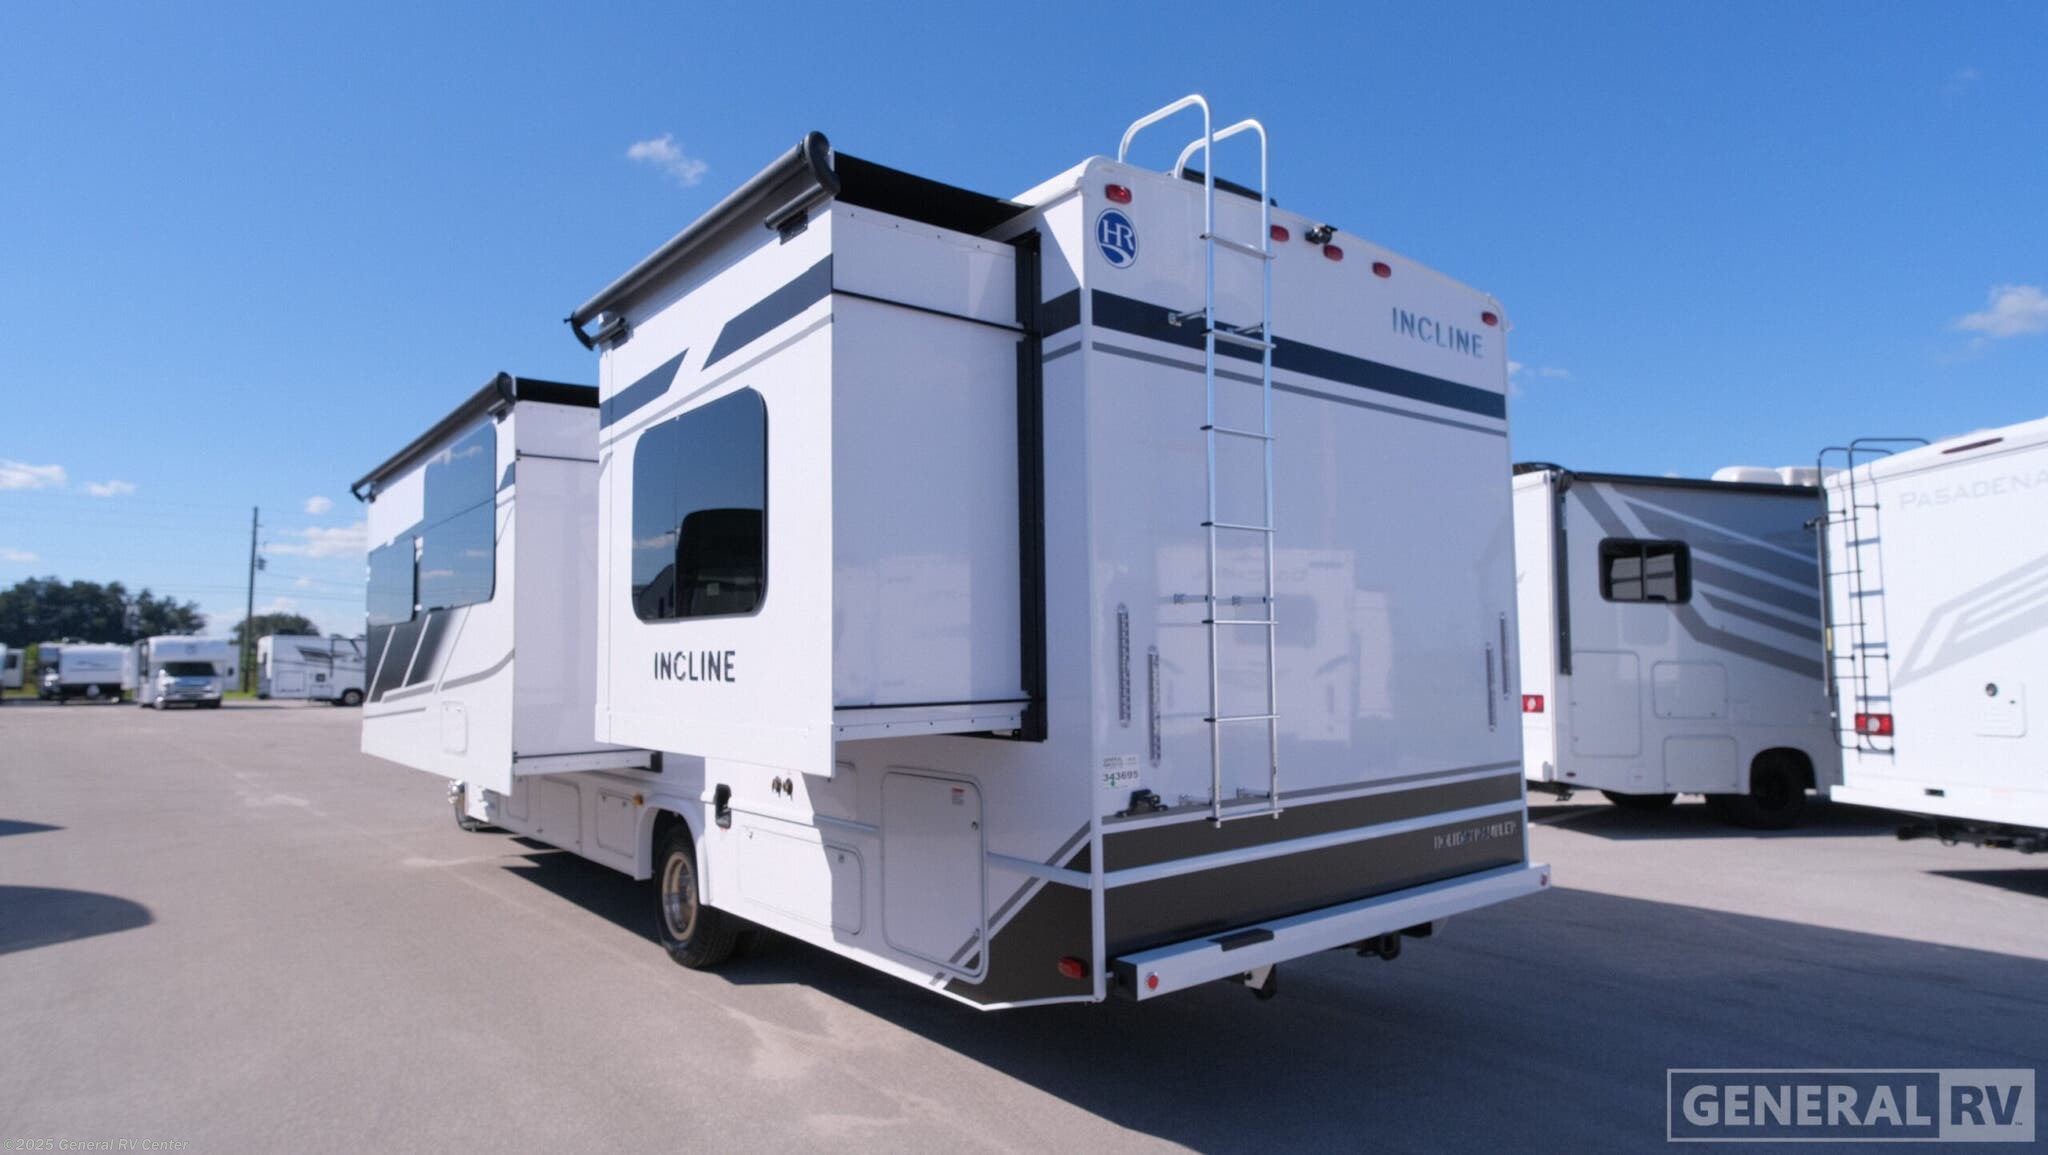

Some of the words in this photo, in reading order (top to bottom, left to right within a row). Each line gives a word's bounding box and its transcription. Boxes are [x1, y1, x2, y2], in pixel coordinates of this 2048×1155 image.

[1101, 218, 1135, 251] HR
[1392, 306, 1484, 359] INCLINE
[1898, 468, 2048, 512] PASADENA
[654, 650, 736, 683] INCLINE
